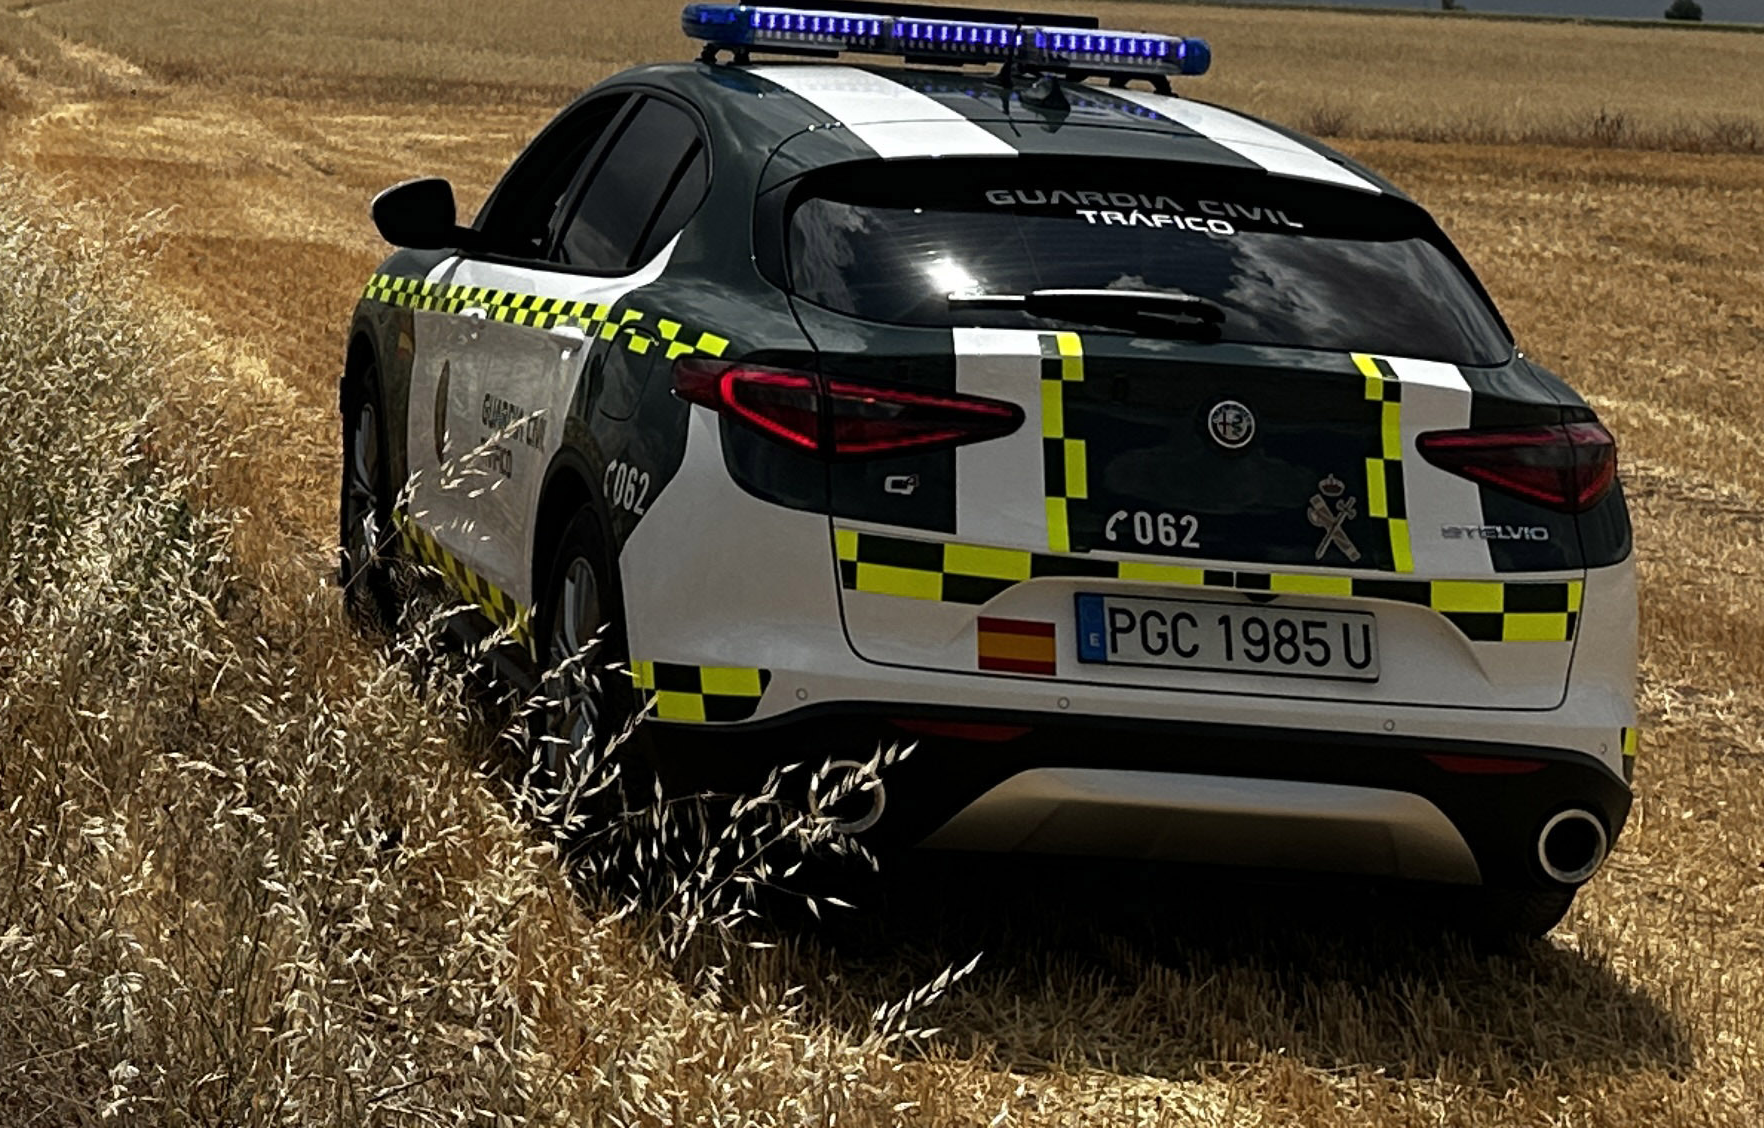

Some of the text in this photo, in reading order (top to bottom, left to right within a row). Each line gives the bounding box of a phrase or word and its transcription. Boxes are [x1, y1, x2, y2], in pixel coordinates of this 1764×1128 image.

[986, 190, 1304, 228] GUARDIA CIVIL
[1076, 208, 1235, 235] TRÁFICO
[613, 462, 650, 516] 062
[1134, 511, 1200, 549] 062
[1089, 632, 1101, 648] E
[1107, 606, 1372, 670] PGC 1985 U
